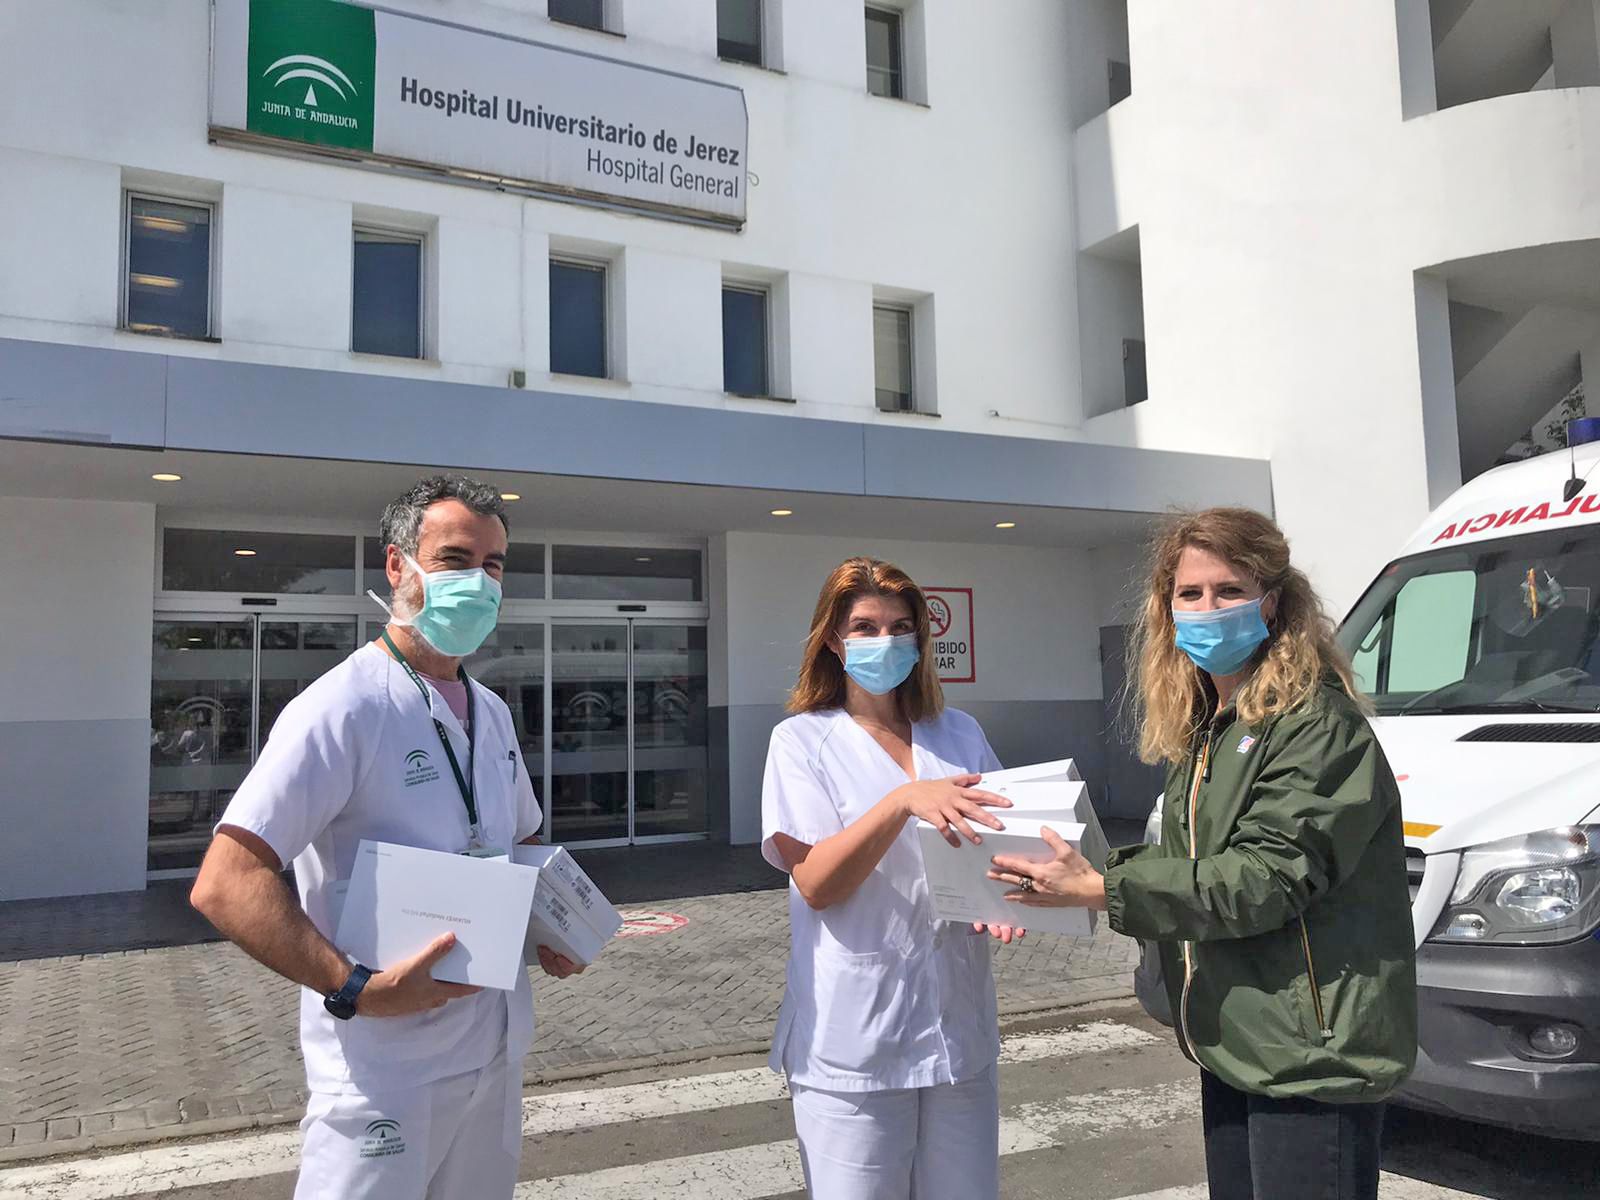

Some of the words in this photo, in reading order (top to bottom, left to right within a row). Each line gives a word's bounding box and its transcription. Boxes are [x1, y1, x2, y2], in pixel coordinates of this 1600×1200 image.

[261, 101, 291, 117] JUNTA
[295, 107, 307, 120] DE
[309, 110, 358, 129] ANDALUCIA
[400, 75, 499, 120] Hospital
[506, 98, 647, 149] Universitario
[652, 129, 678, 155] de
[684, 134, 740, 167] Jerez
[586, 147, 664, 184] Hospital
[669, 163, 739, 199] General
[932, 641, 967, 654] IBIDO
[935, 656, 956, 669] AR
